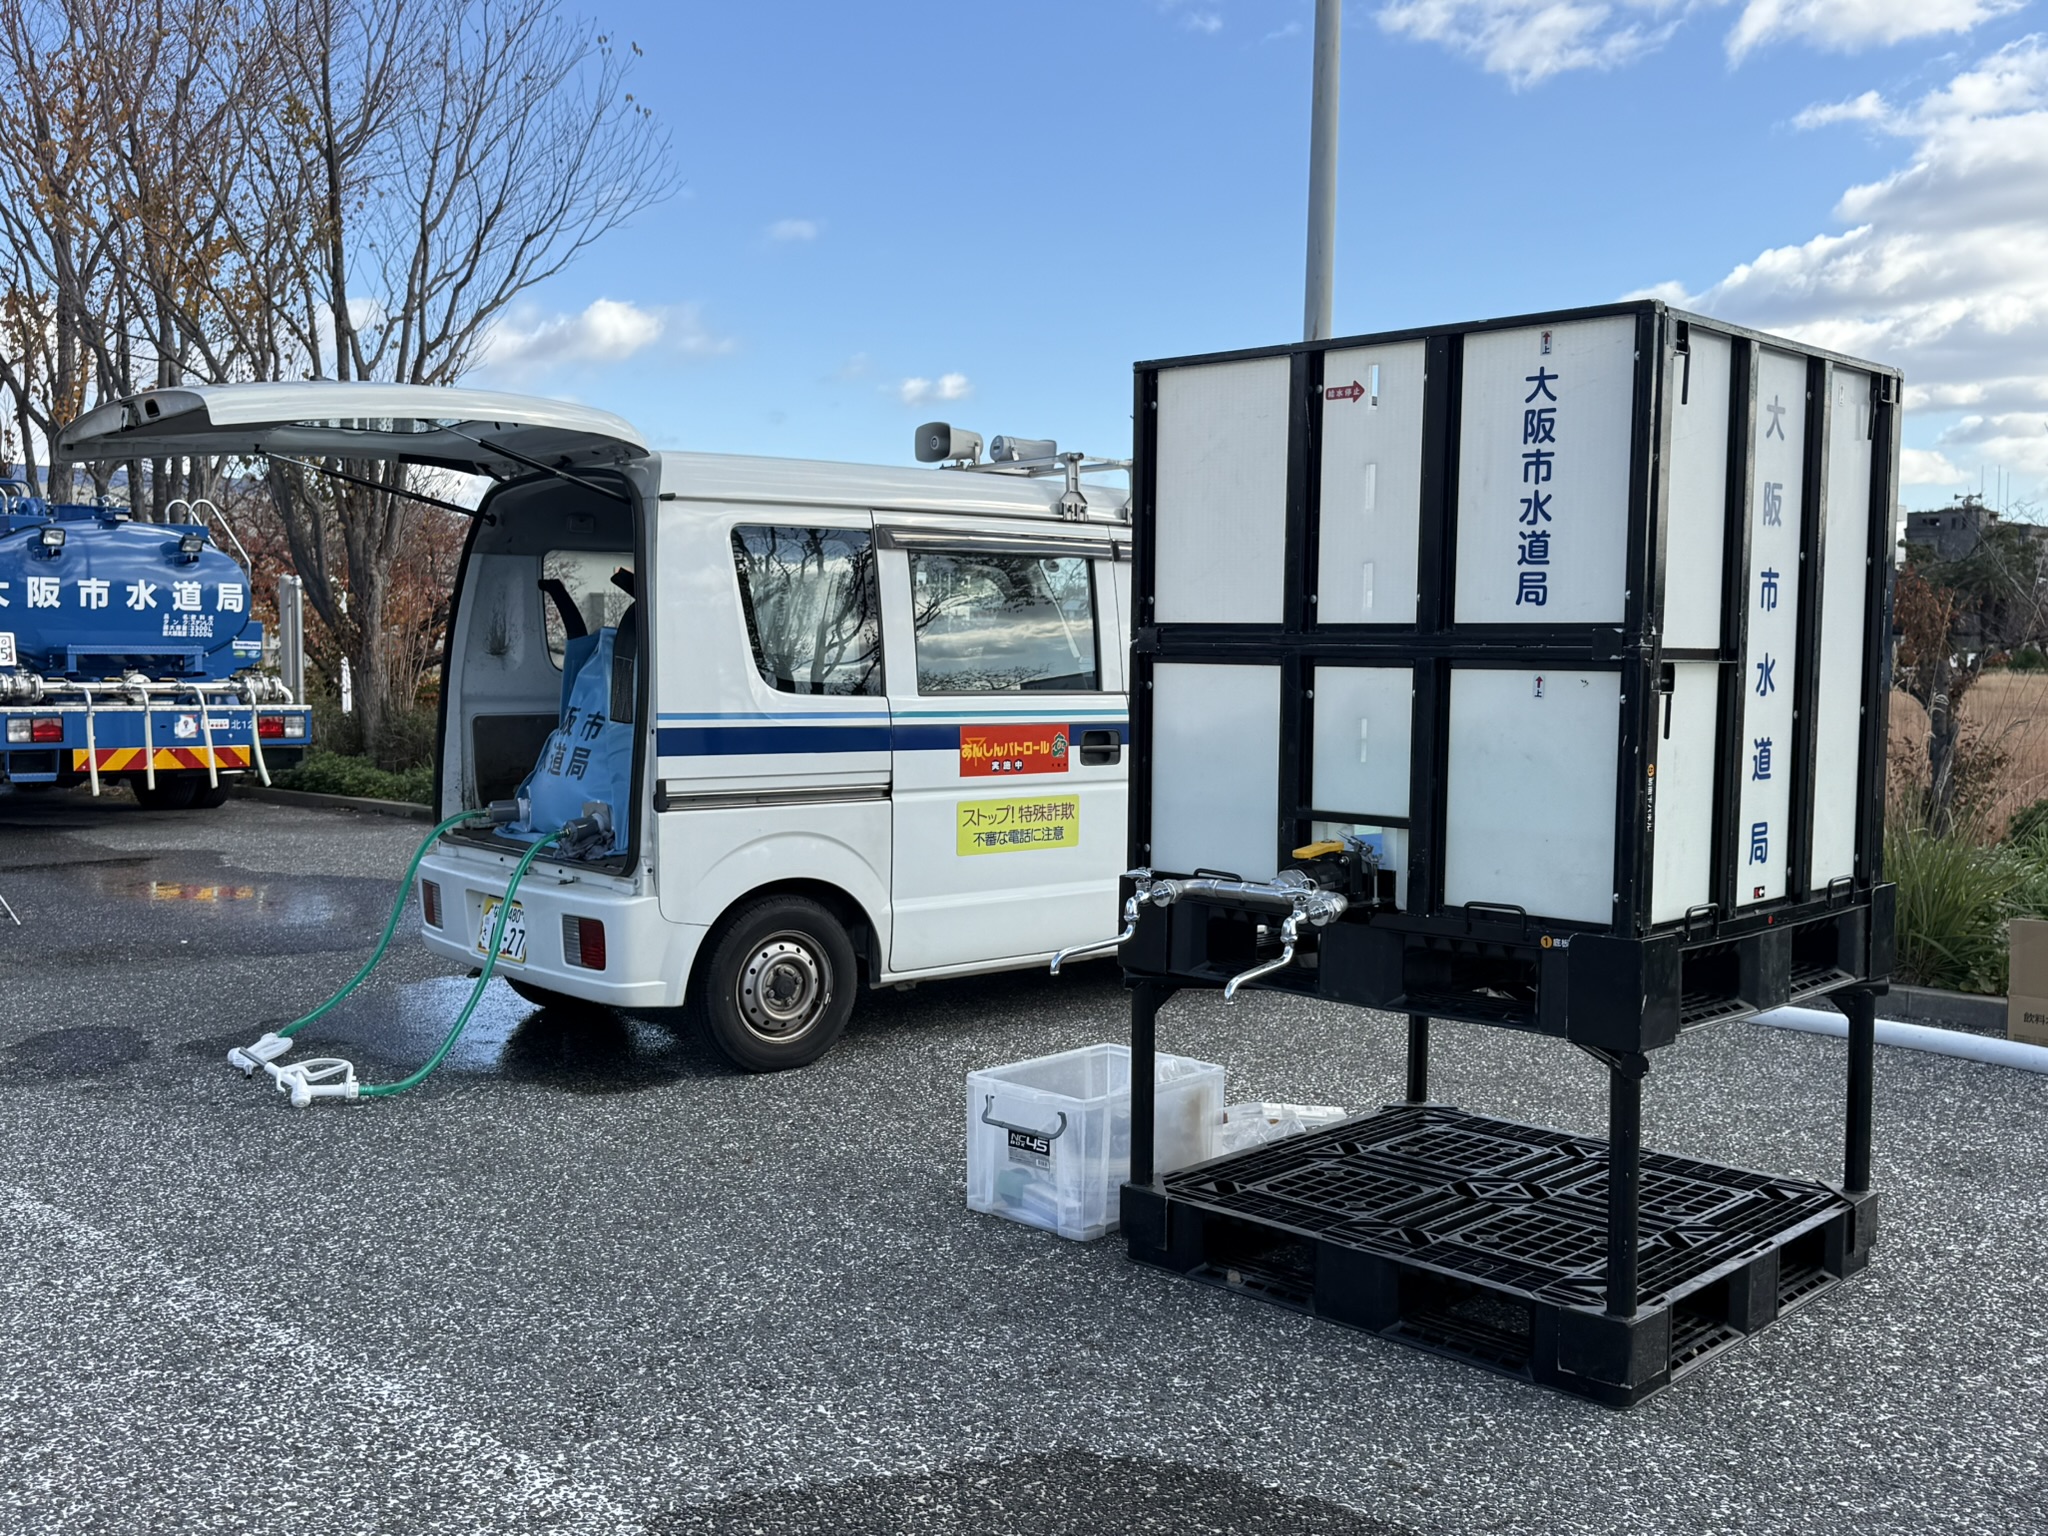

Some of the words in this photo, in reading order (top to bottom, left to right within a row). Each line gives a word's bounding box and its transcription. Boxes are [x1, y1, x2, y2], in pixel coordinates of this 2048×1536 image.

[1516, 366, 1559, 606] 大阪市水道局
[1748, 395, 1786, 865] 大阪市水道局
[961, 740, 1050, 759] あんしんパトロール
[539, 741, 592, 781] 道局
[991, 760, 1023, 772] 実施中
[973, 826, 1064, 847] 不審な電話に注意
[2023, 1011, 2048, 1026] 飲料
[1026, 1136, 1048, 1152] 45
